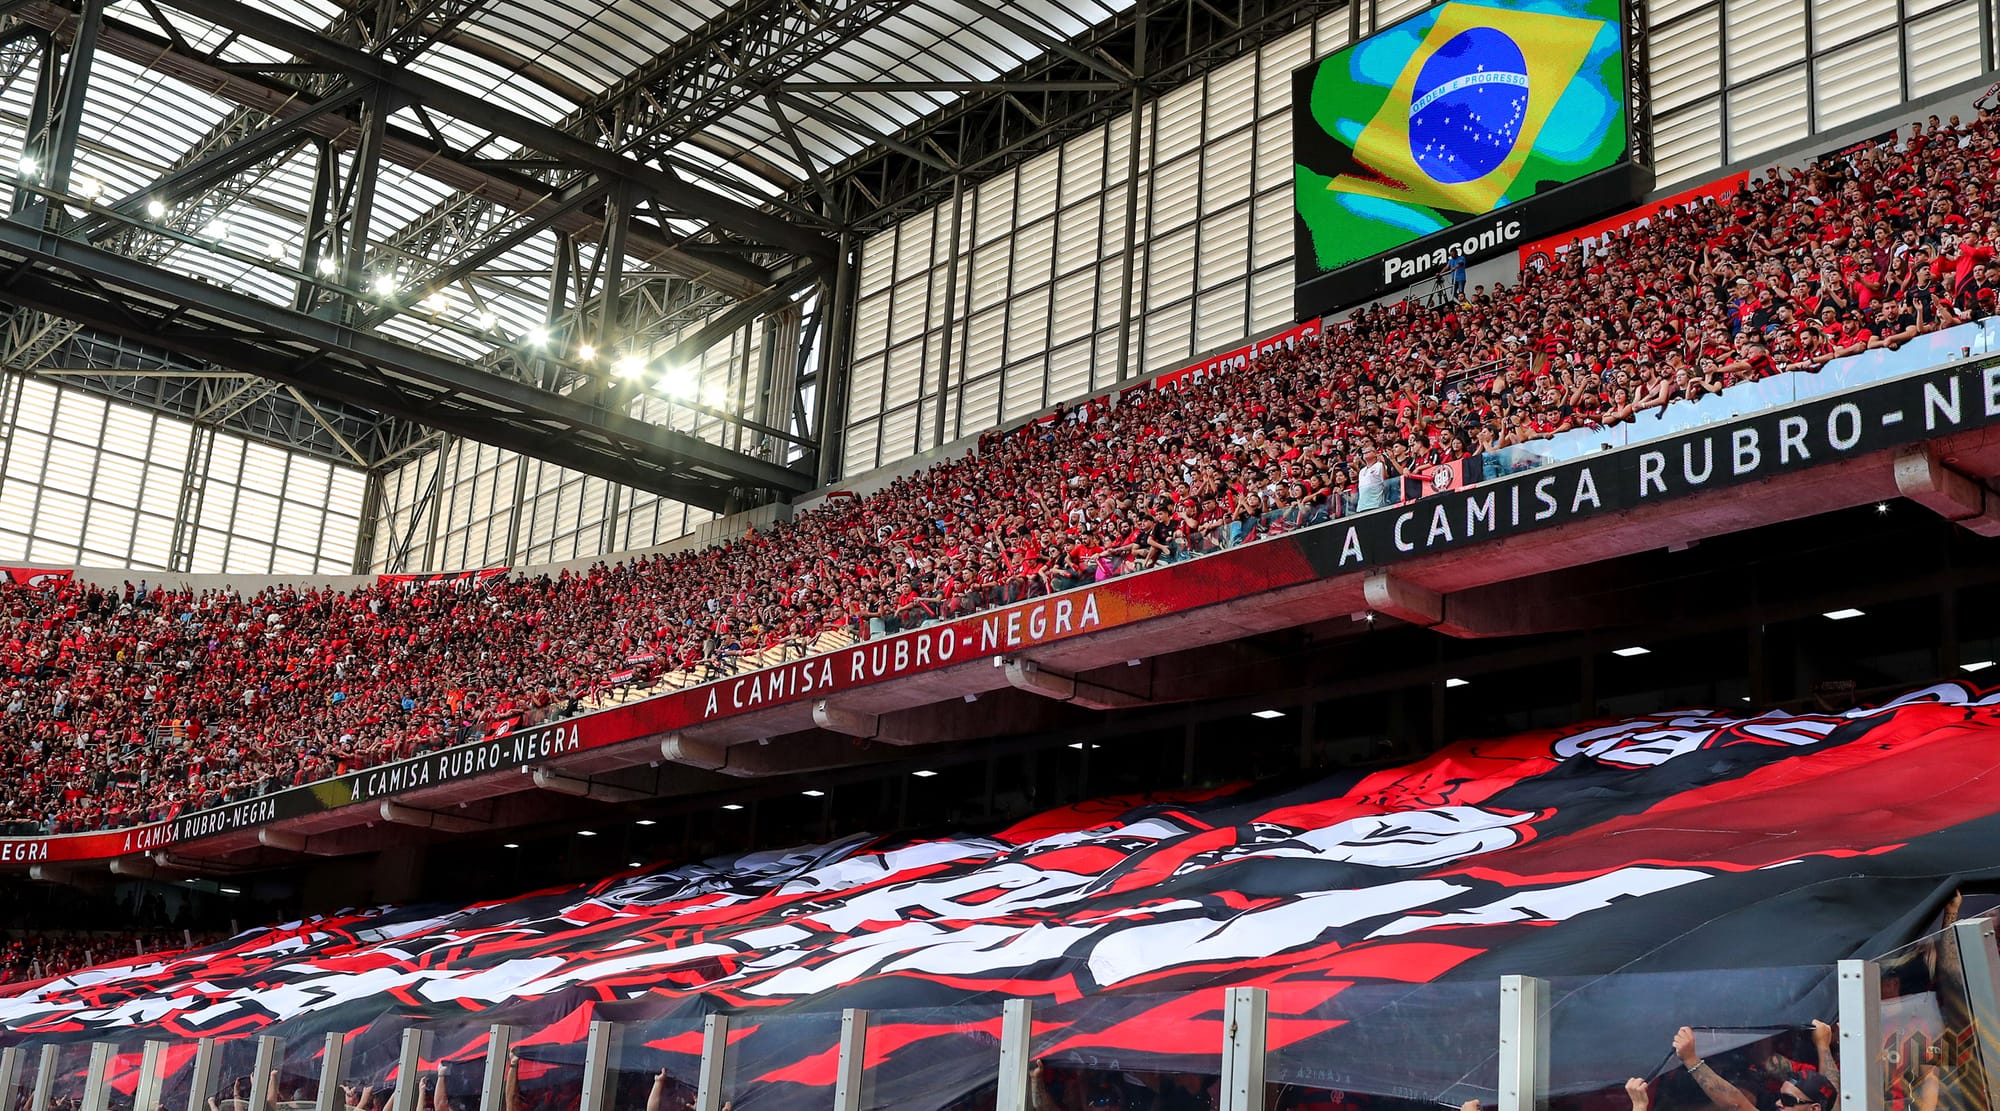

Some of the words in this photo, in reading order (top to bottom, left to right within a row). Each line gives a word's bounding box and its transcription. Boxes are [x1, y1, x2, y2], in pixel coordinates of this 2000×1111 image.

[1412, 86, 1446, 113] ORDEM
[1465, 73, 1525, 85] PROGRESSO
[1384, 220, 1521, 285] Panasonic
[1338, 526, 1364, 567] A
[1394, 467, 1601, 552] CAMISA
[704, 688, 718, 718] A
[733, 658, 833, 709] CAMISA
[850, 592, 1100, 682] RUBRO-NEGRA
[351, 779, 360, 801] A
[368, 761, 430, 796] CAMISA
[438, 724, 579, 780] RUBRO-NEGRA
[123, 833, 131, 851] A
[136, 822, 180, 849] CAMISA
[184, 799, 275, 840] RUBRO-NEGRA
